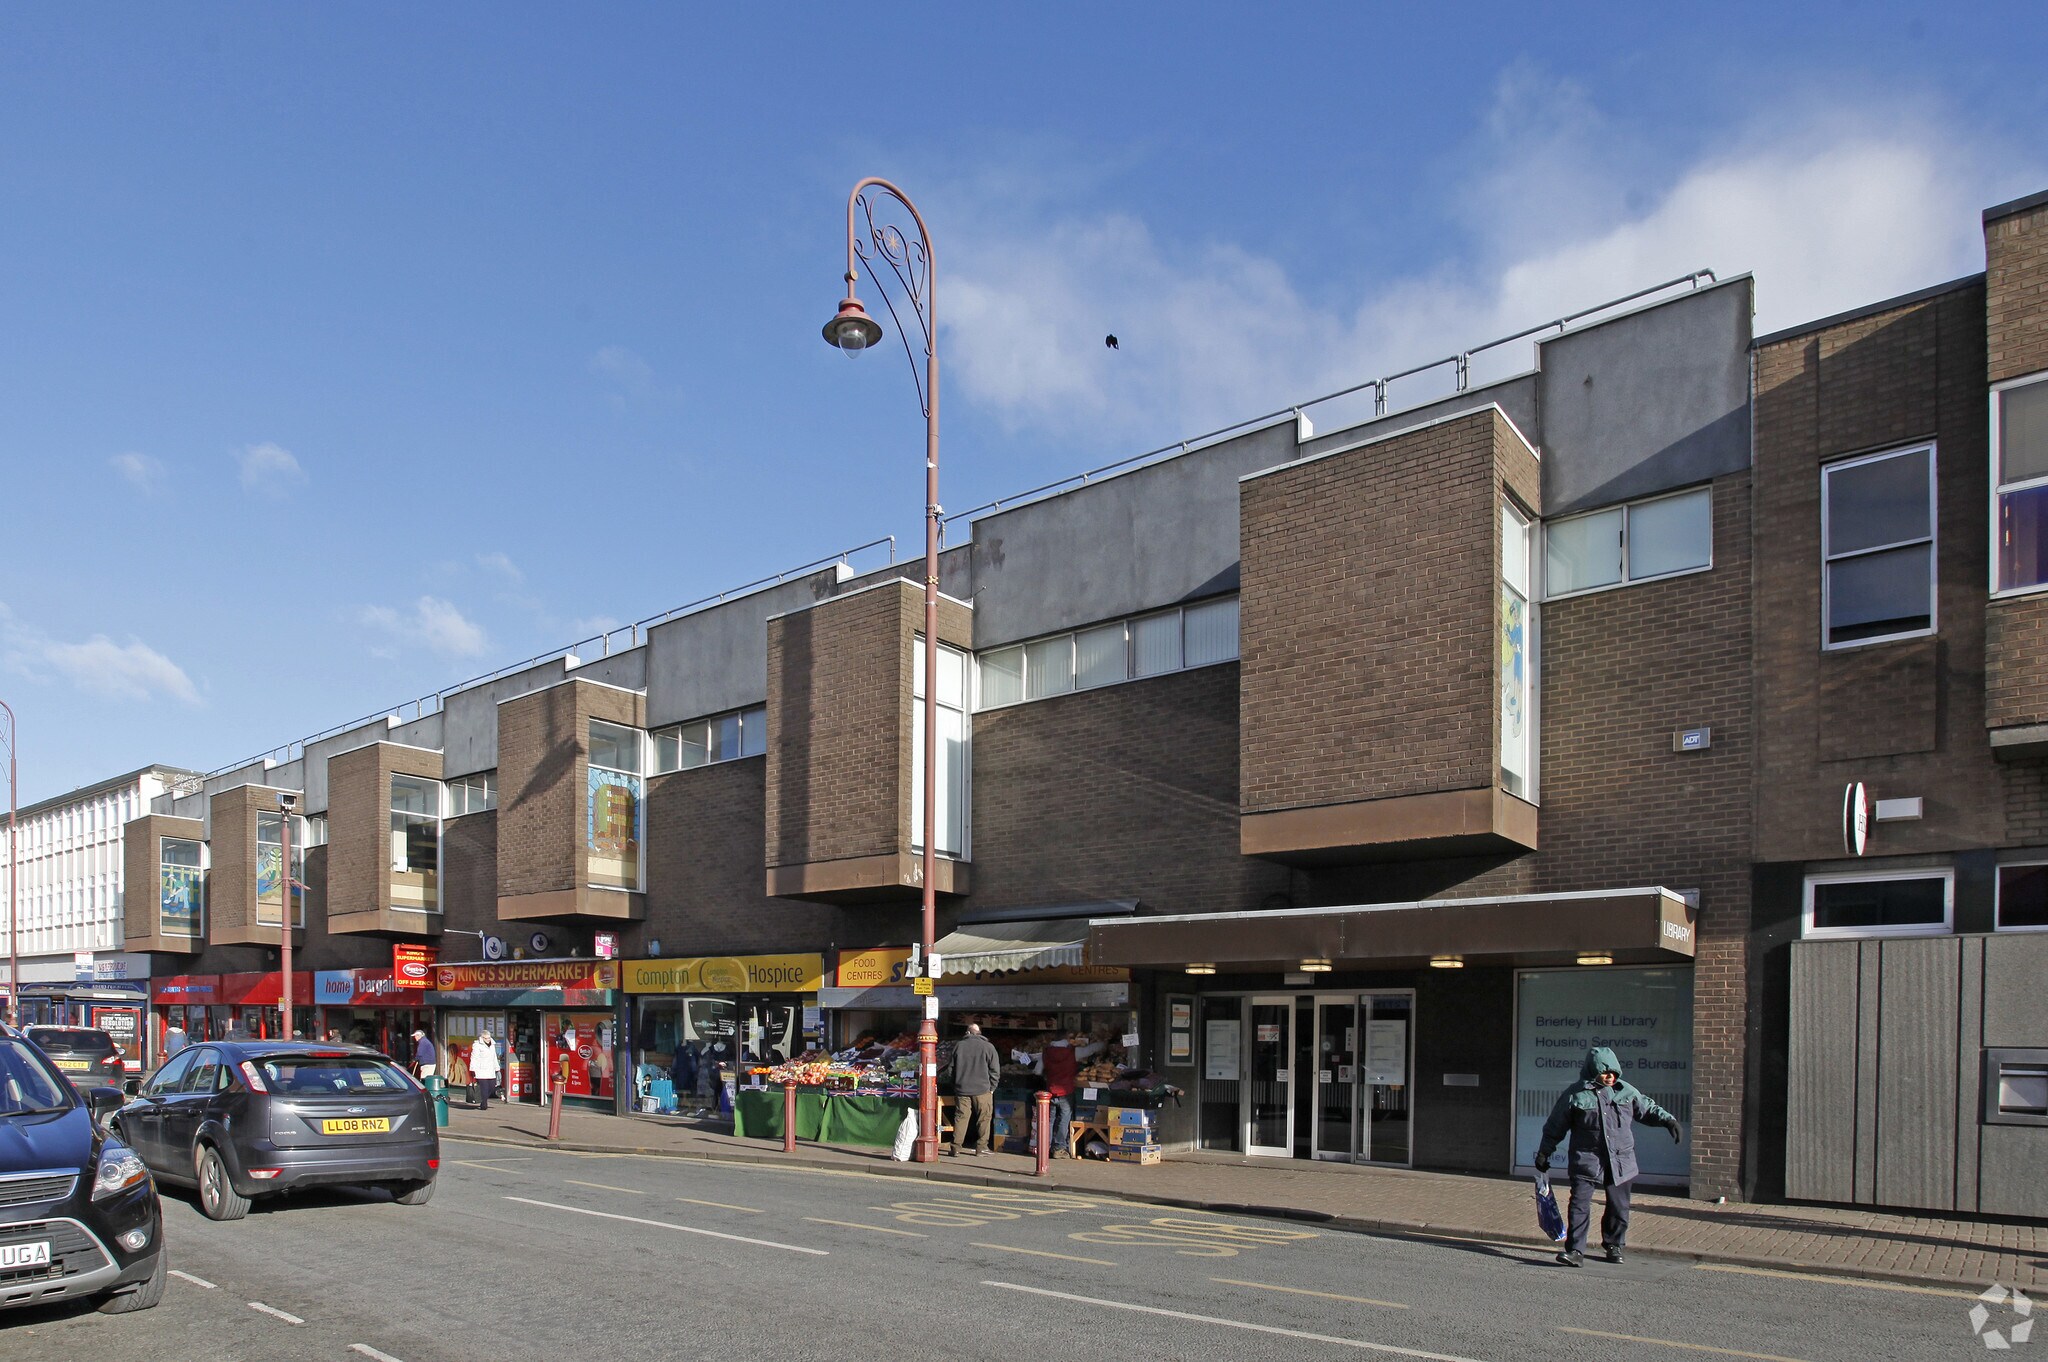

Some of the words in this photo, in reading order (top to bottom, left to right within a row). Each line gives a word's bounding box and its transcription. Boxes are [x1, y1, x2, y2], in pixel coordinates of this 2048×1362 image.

[1683, 733, 1700, 745] ADT
[1663, 920, 1691, 942] LIBRARY
[853, 958, 876, 968] FOOD
[457, 966, 496, 983] KING'S
[498, 962, 592, 982] SUPERMARKET
[636, 967, 690, 987] Compton
[748, 962, 803, 988] Hospice
[846, 970, 883, 981] CENTRES
[1071, 966, 1119, 977] CENTRES
[325, 978, 351, 994] home
[1535, 1016, 1583, 1029] Brierley
[1587, 1016, 1607, 1026] Hill
[1611, 1016, 1658, 1029] Library
[1535, 1036, 1587, 1049] Housing
[1591, 1036, 1648, 1048] Services
[1638, 1058, 1687, 1070] Bureau
[328, 1120, 359, 1132] LL08
[361, 1119, 384, 1130] RNZ
